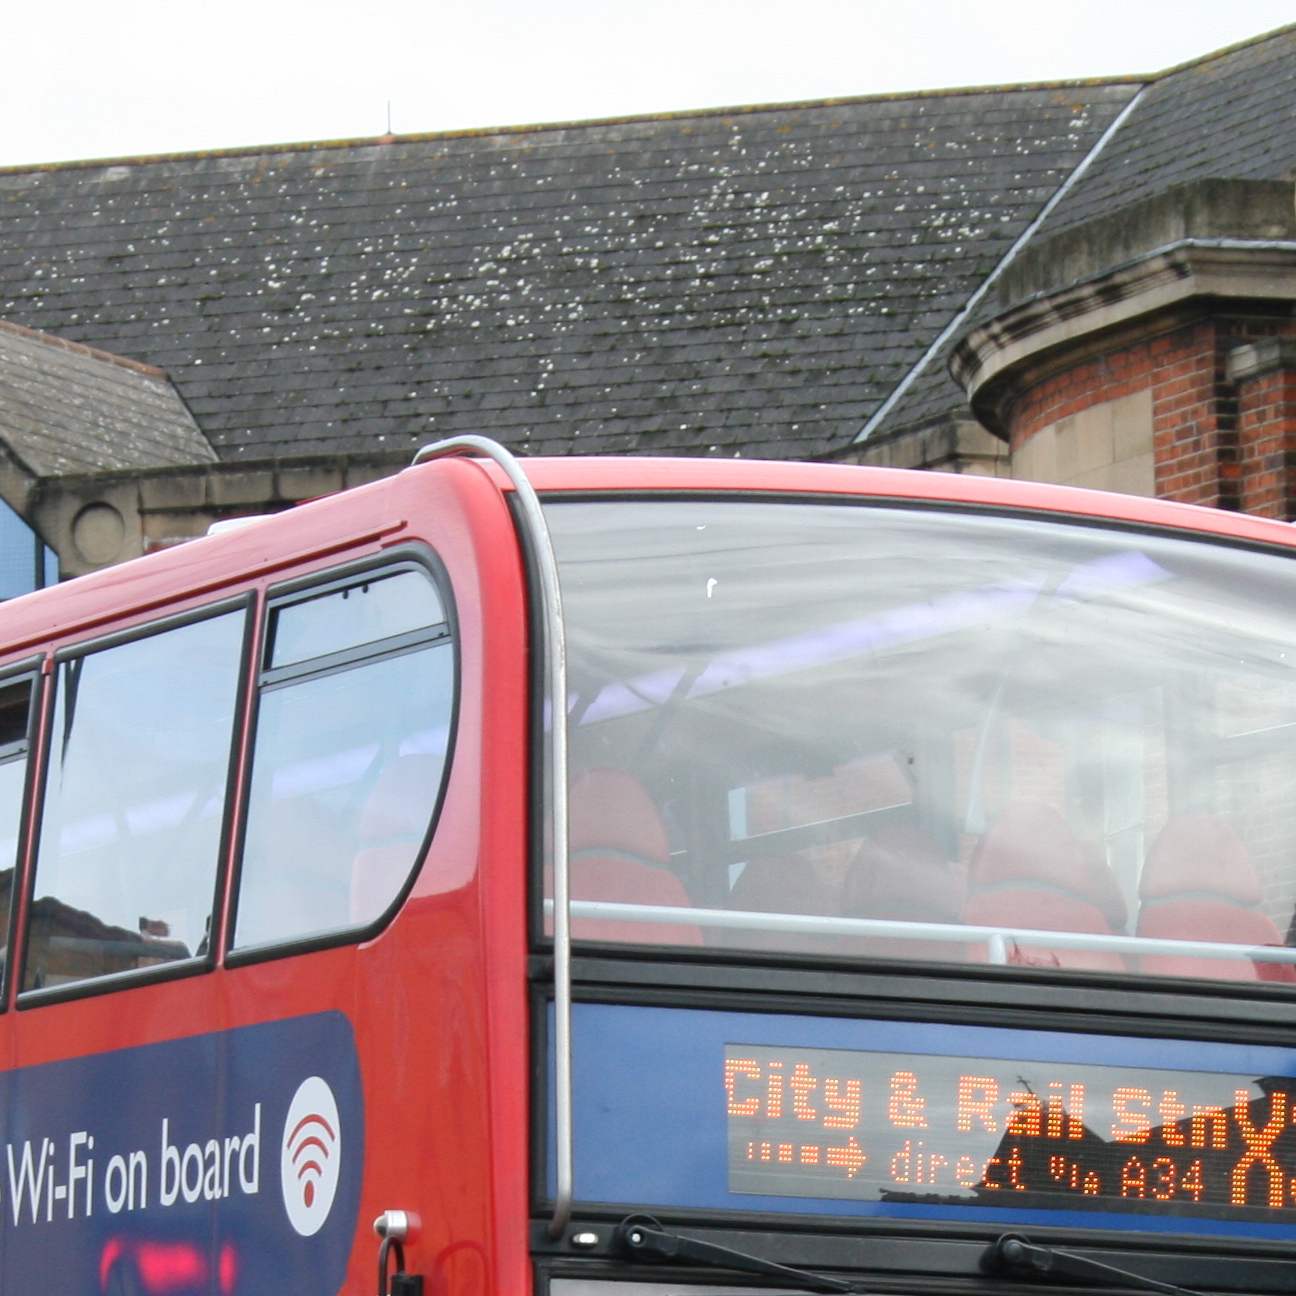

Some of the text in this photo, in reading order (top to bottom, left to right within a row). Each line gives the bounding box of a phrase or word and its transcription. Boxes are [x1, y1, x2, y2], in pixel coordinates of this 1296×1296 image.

[724, 1058, 1228, 1149] City & Rail Stn
[6, 1131, 96, 1228] Wi-Fi
[104, 1145, 149, 1215] on
[159, 1102, 263, 1208] board
[889, 1139, 1204, 1203] direct via A34
